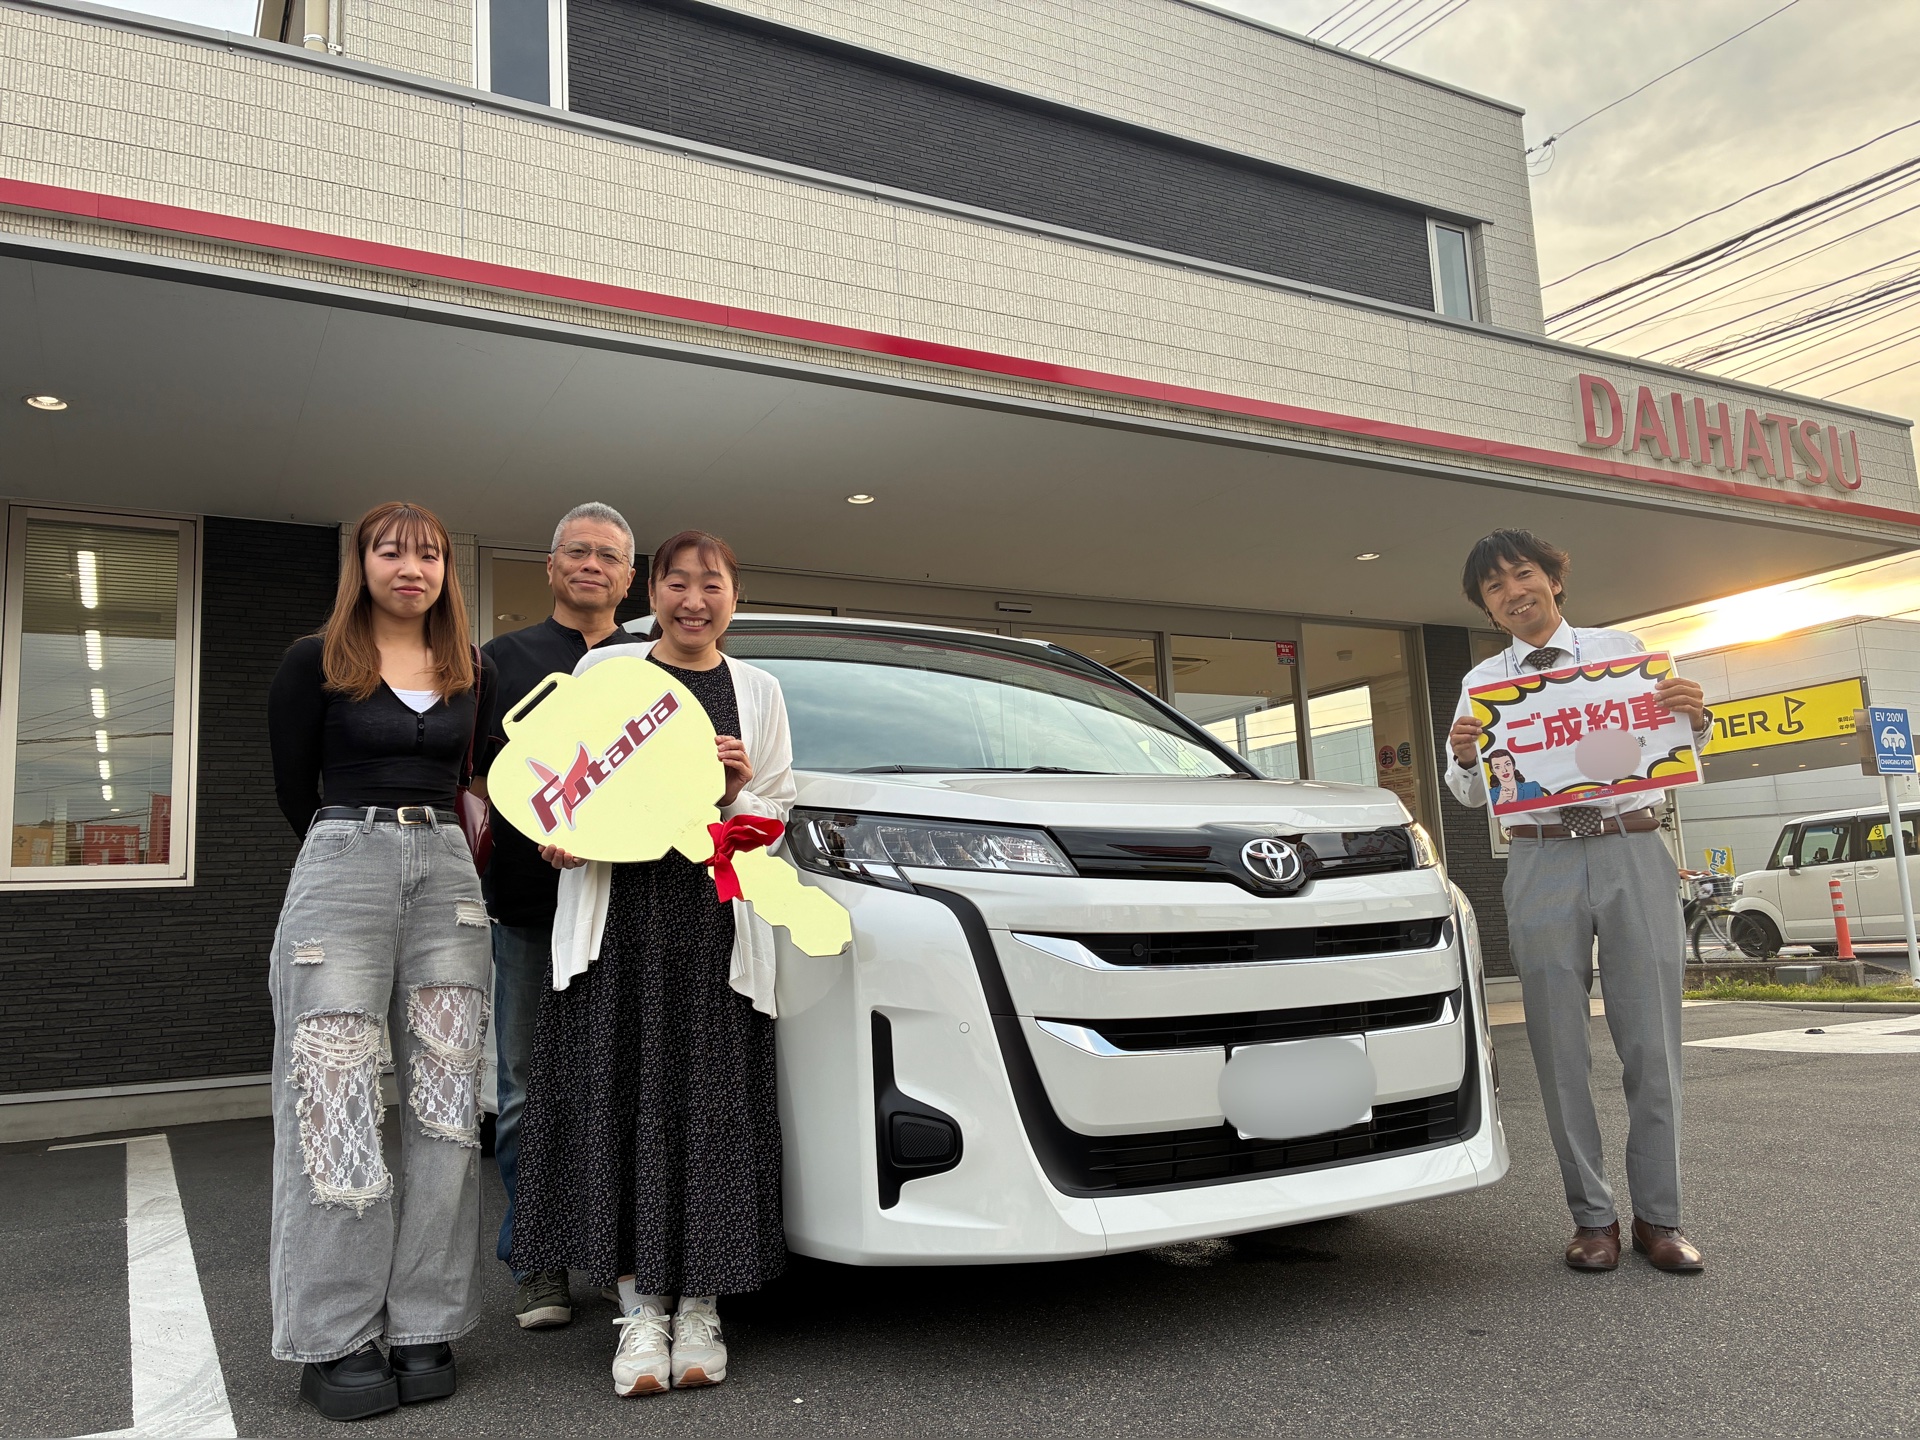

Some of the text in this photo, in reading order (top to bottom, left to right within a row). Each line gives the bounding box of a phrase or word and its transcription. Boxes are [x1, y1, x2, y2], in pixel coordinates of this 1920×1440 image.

[1575, 373, 1862, 491] DAIHATSU
[530, 690, 680, 834] Futaba
[1506, 691, 1676, 754] ご成約車
[1875, 711, 1904, 723] EV 200V
